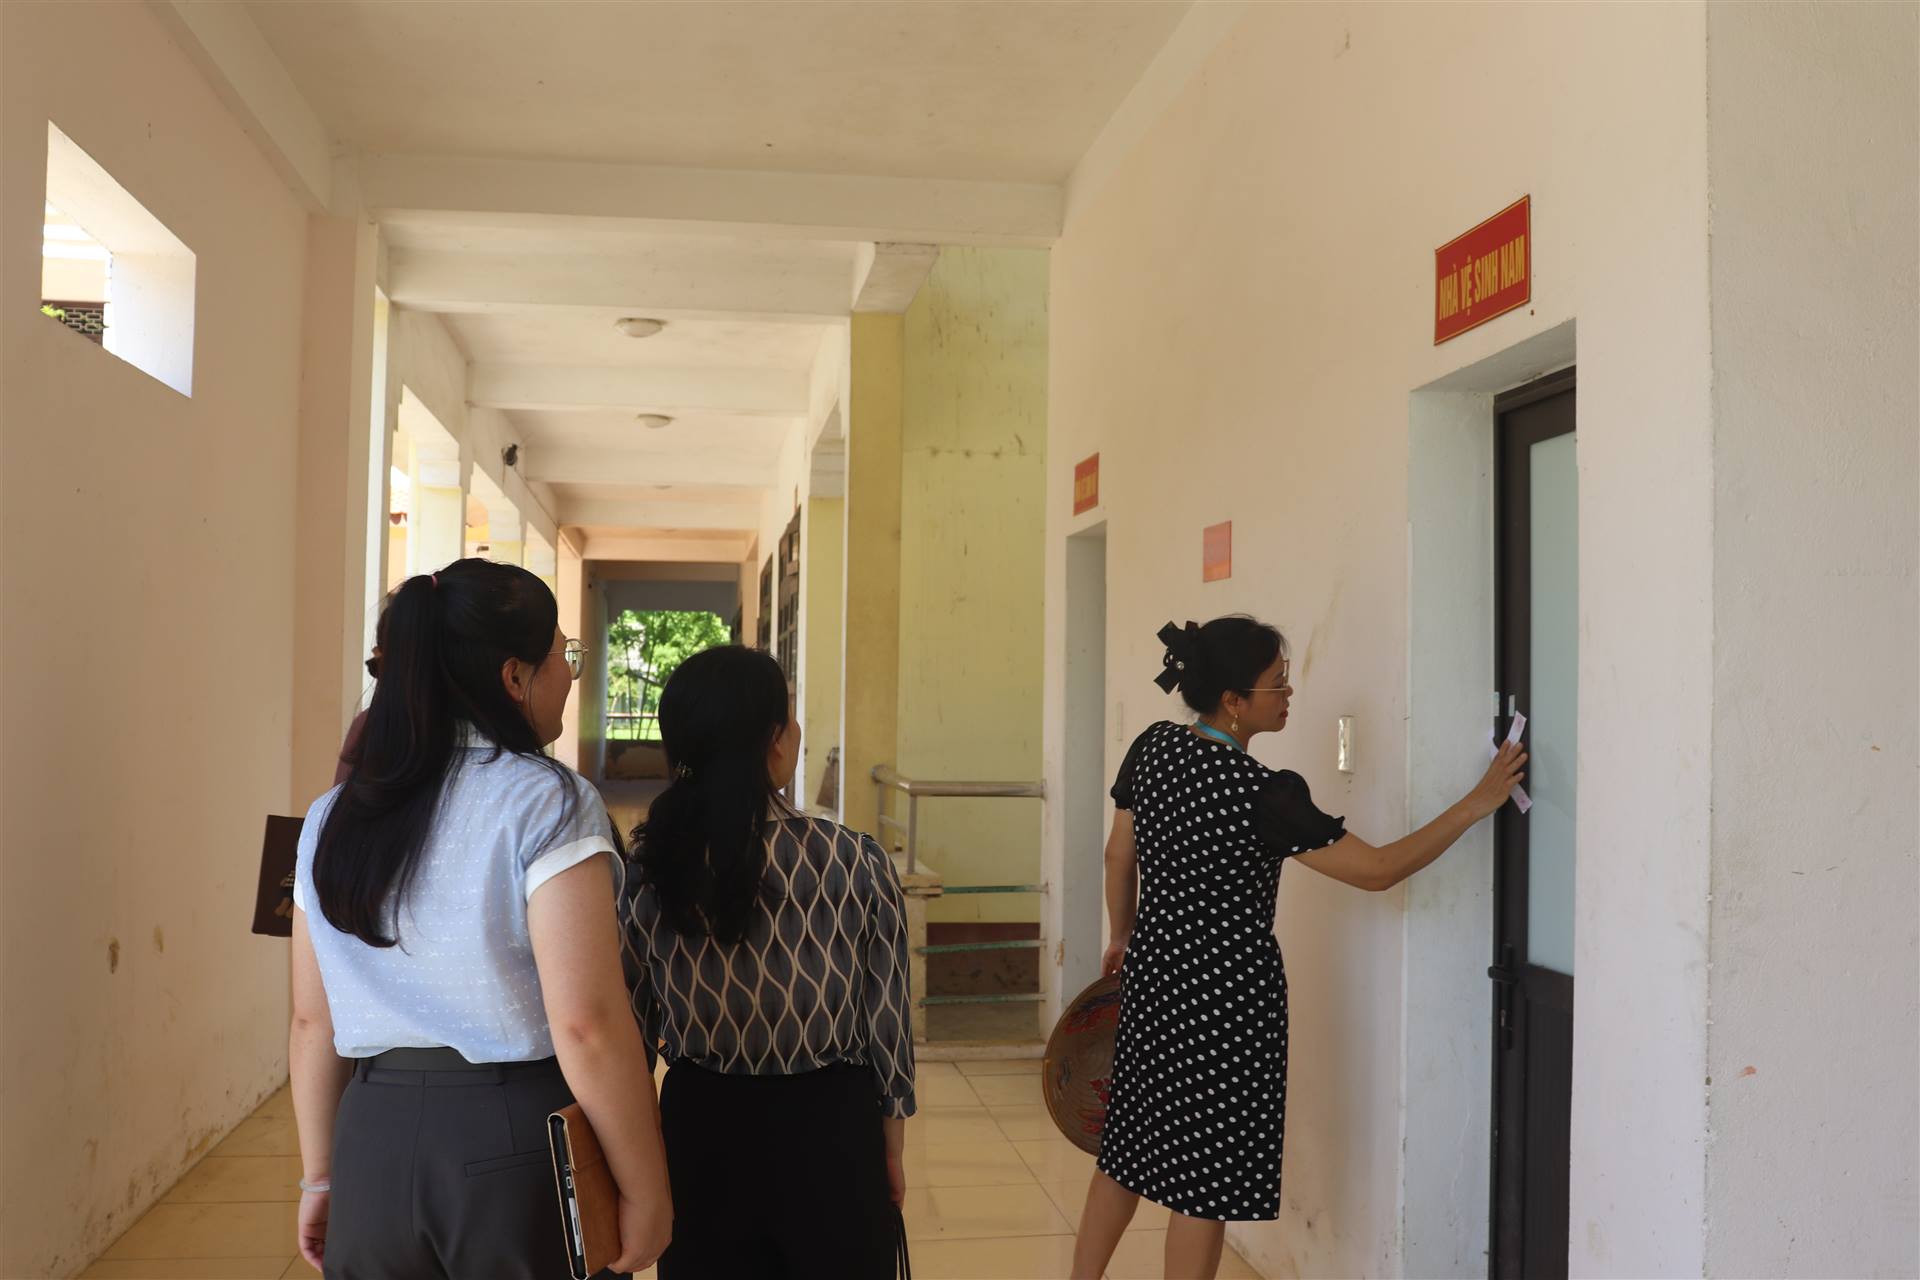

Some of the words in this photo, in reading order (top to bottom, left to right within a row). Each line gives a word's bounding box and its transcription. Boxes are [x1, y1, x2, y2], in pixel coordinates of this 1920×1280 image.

[1439, 264, 1458, 321] NHÀ
[1461, 255, 1472, 316] VỆ
[1474, 249, 1498, 303] SINH
[1500, 234, 1525, 291] NAM
